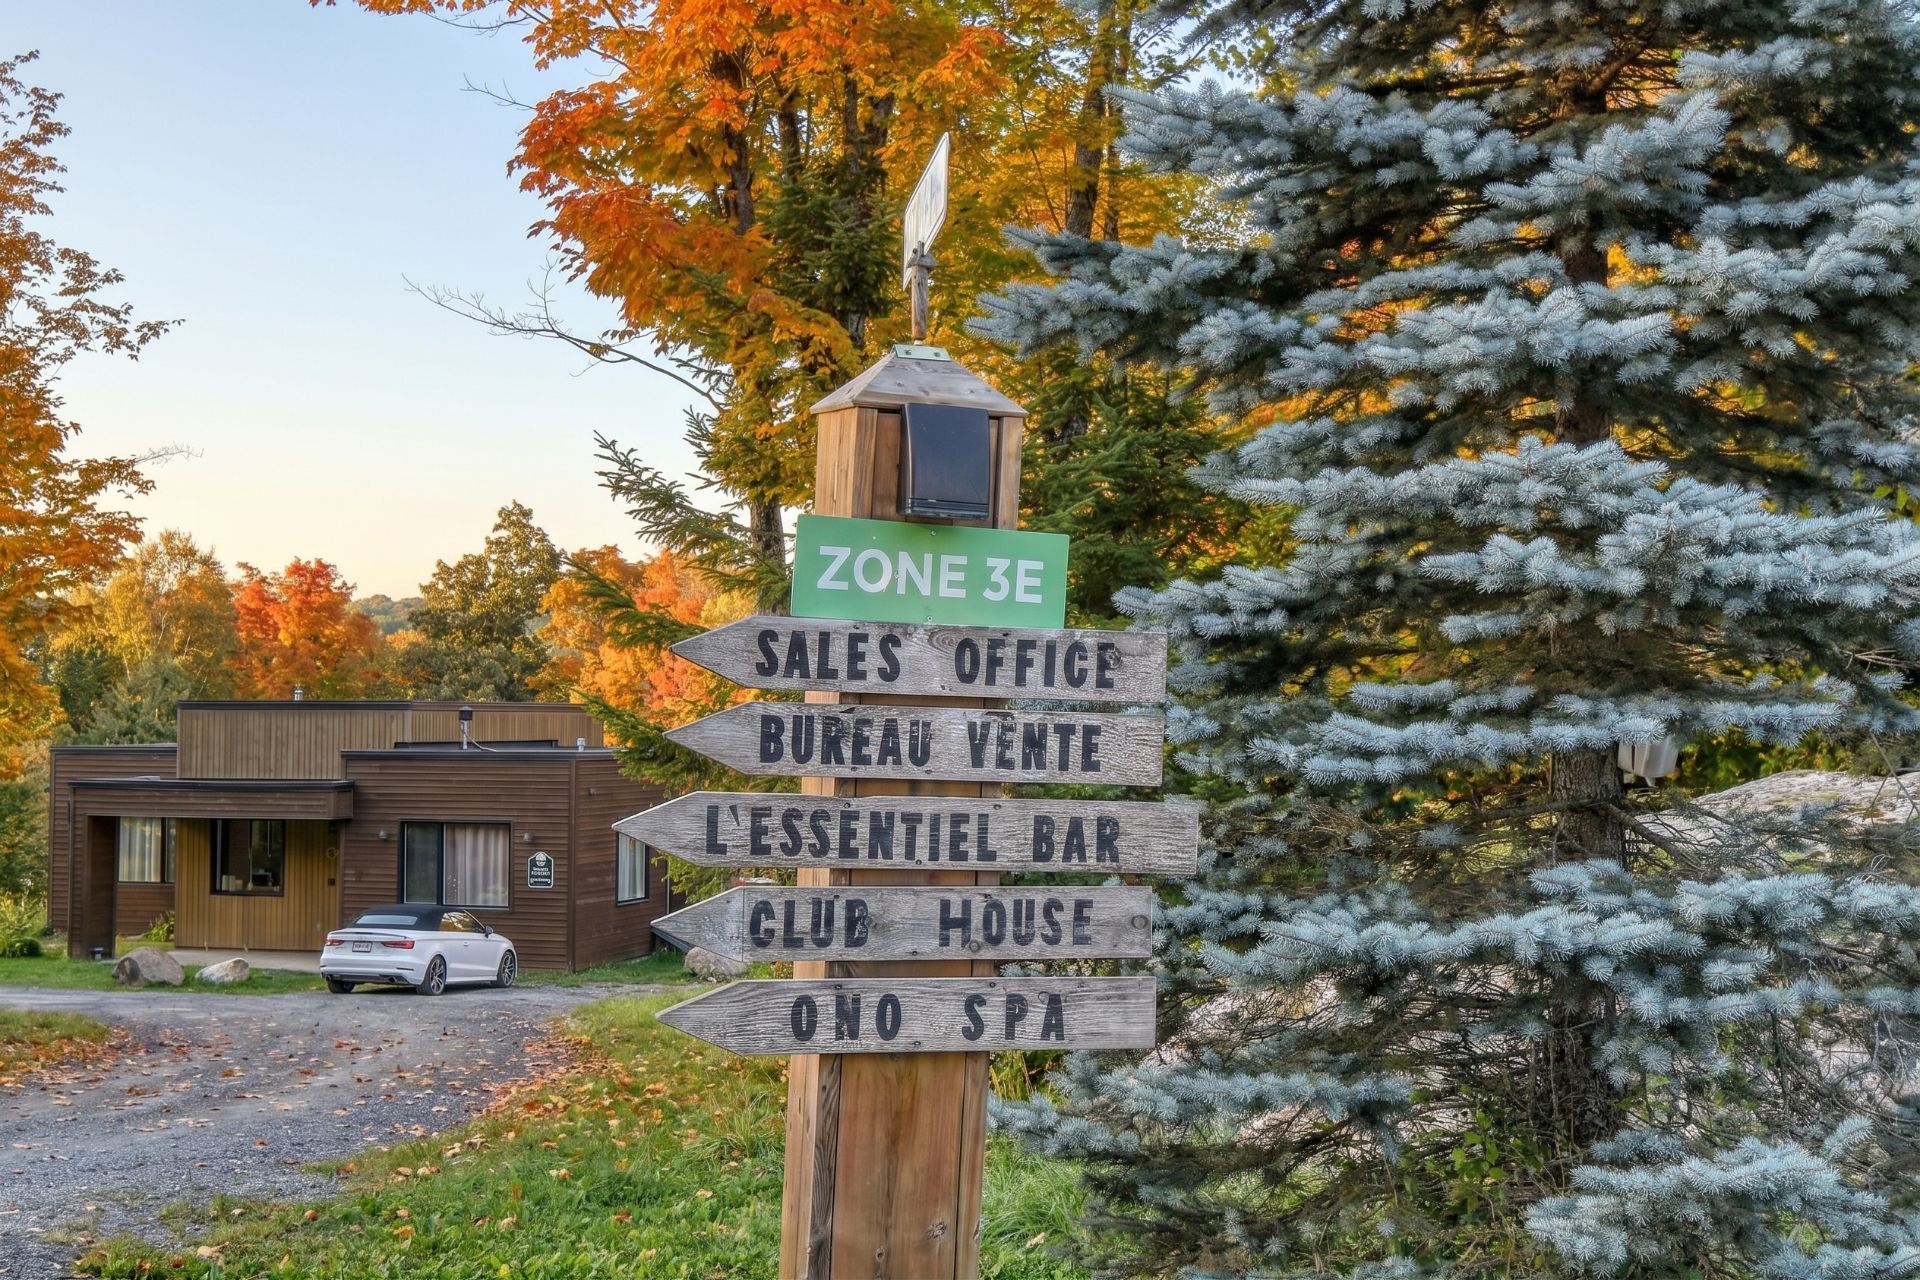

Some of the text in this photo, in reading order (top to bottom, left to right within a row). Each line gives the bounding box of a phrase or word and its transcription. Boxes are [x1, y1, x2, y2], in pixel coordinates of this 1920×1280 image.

[817, 545, 1044, 603] ZONE 3E
[755, 629, 1115, 688] SALES OFFICE
[759, 715, 1101, 771] BUREAU VENTE
[1032, 815, 1121, 863] BAR
[749, 898, 1094, 948] CLUB HOUSE
[791, 992, 1064, 1042] ONO SPA
